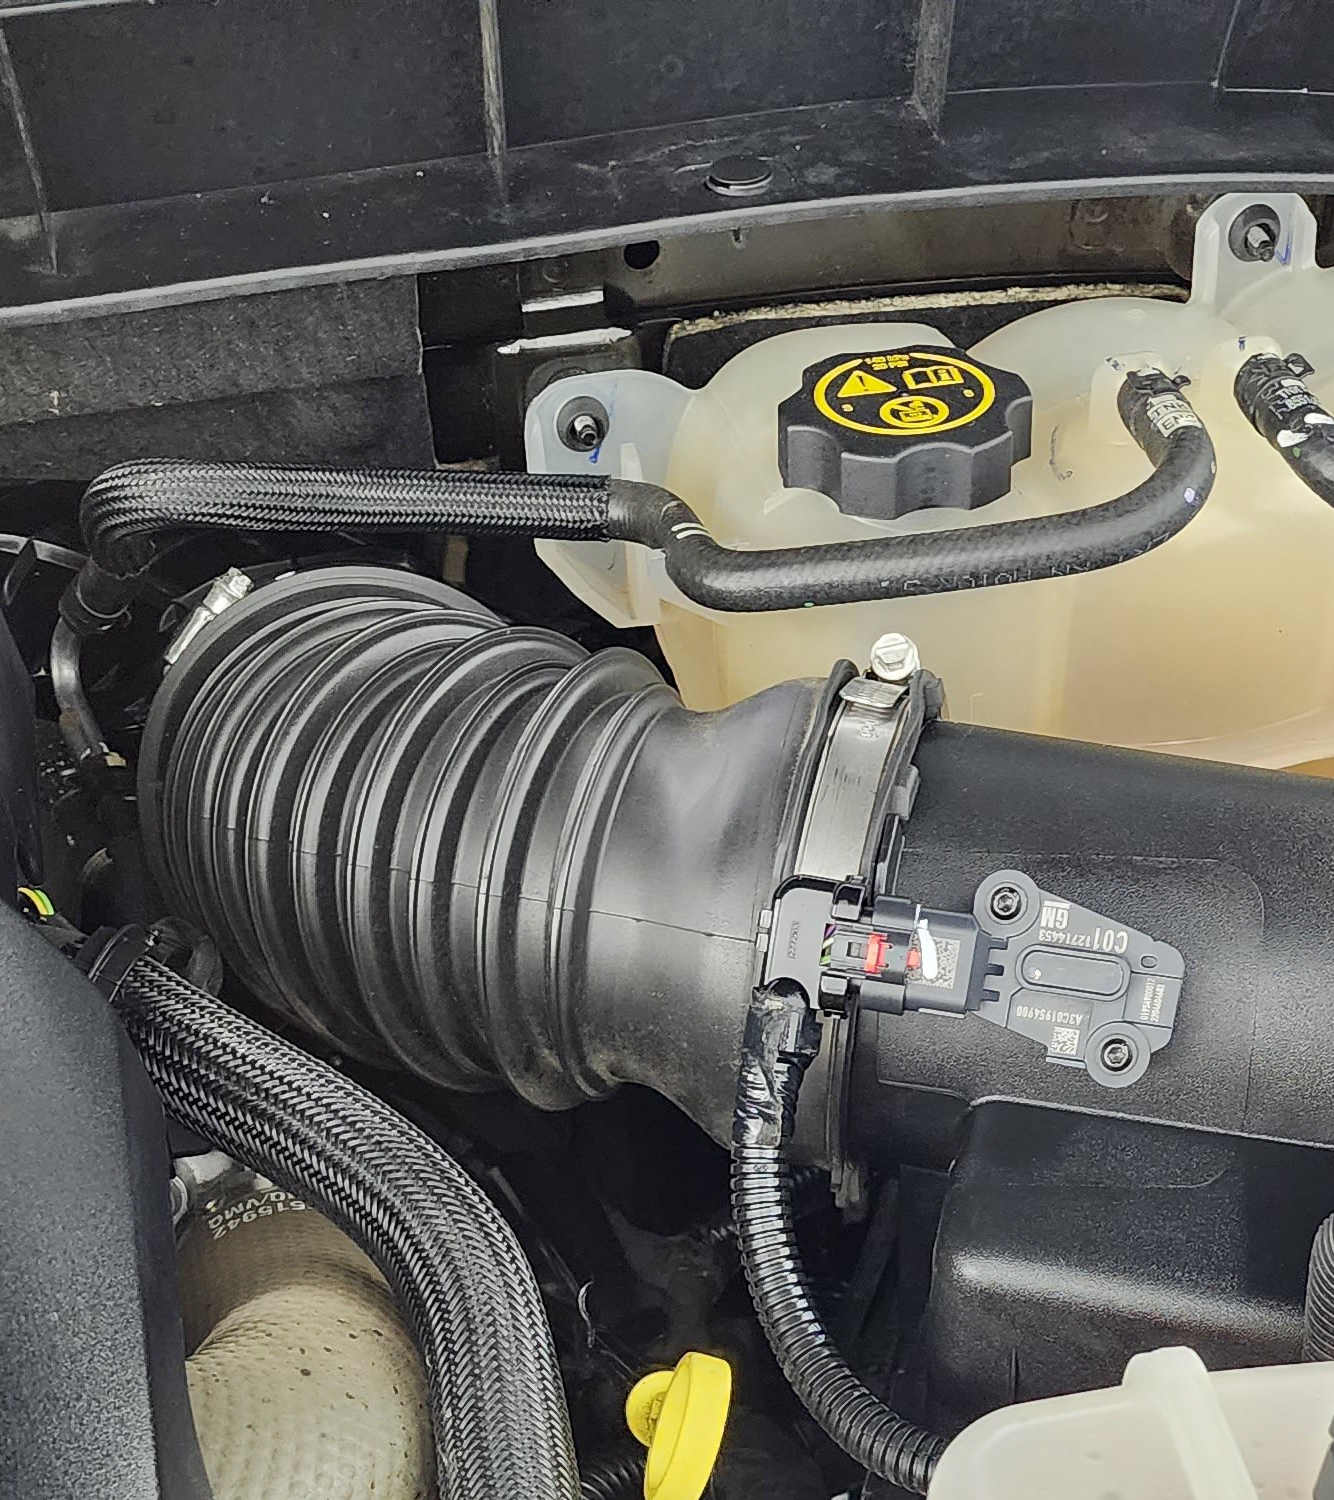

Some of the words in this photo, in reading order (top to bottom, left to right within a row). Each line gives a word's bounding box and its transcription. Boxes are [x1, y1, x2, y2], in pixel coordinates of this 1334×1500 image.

[1039, 906, 1069, 930] GM
[208, 1191, 295, 1230] Q/VMQ
[212, 1200, 313, 1240] 515942
